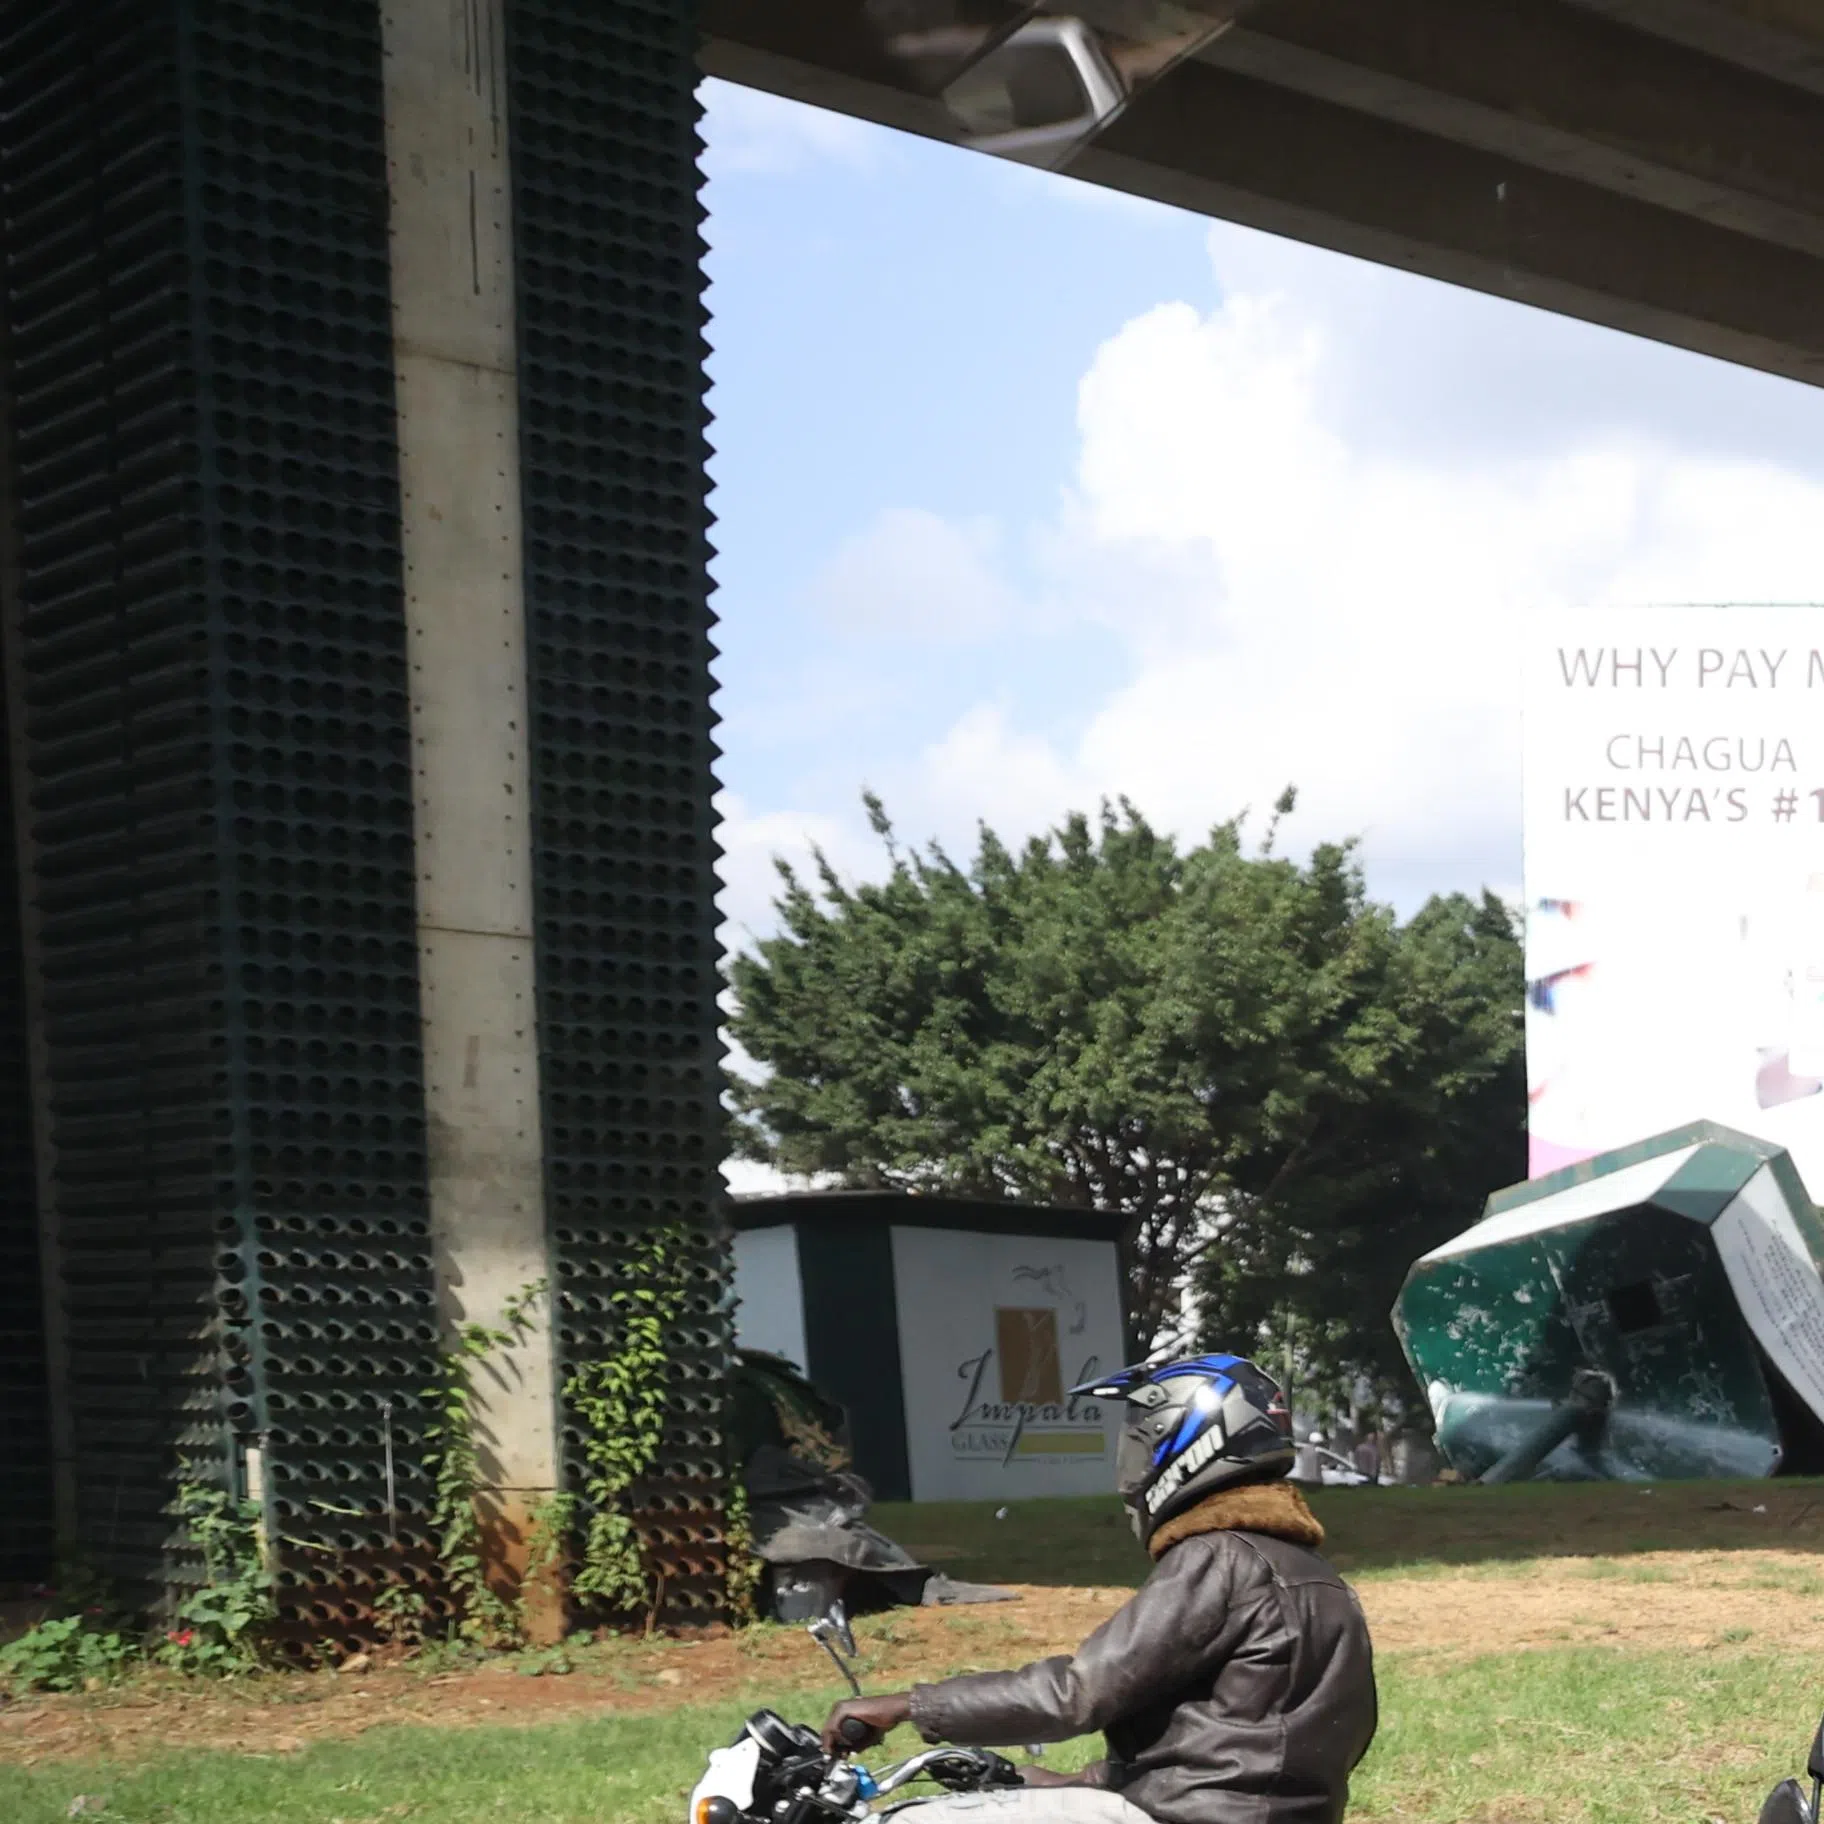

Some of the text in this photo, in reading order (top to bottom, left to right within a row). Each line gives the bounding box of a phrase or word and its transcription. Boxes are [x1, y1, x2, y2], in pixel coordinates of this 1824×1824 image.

[1557, 647, 1678, 688] WHY
[1698, 647, 1788, 688] PAY
[1606, 734, 1797, 772] CHAGUA
[1564, 786, 1748, 823] KENYA'S
[949, 1348, 1102, 1468] Impala
